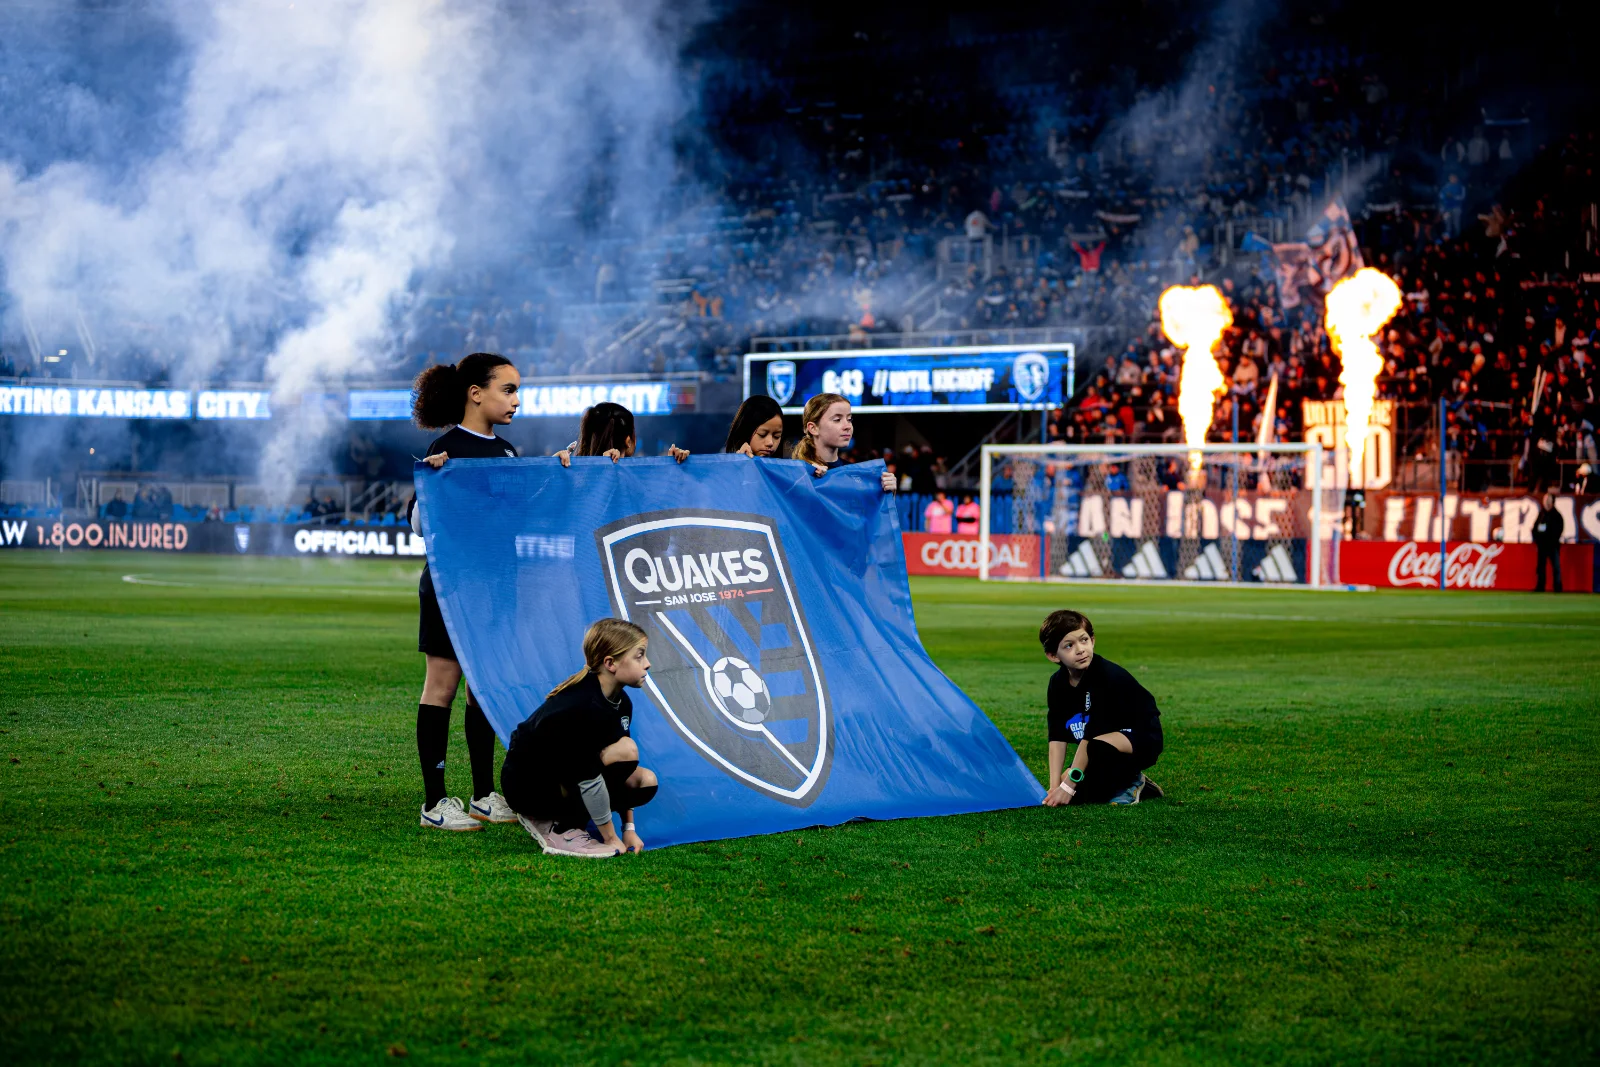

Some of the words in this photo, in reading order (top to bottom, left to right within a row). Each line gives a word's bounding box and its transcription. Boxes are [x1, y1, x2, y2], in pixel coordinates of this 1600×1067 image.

[932, 367, 995, 393] KICKOFF
[77, 389, 188, 418] KANSAS
[198, 391, 262, 418] CITY
[611, 383, 663, 412] CITY
[1079, 493, 1144, 539] AN
[37, 521, 189, 550] 1.800.INJURED
[294, 529, 393, 555] OFFICIAL
[396, 532, 427, 556] LE
[624, 547, 770, 594] QUAKES
[663, 594, 689, 606] SAN
[690, 591, 718, 604] JOSE
[718, 588, 745, 600] 1974
